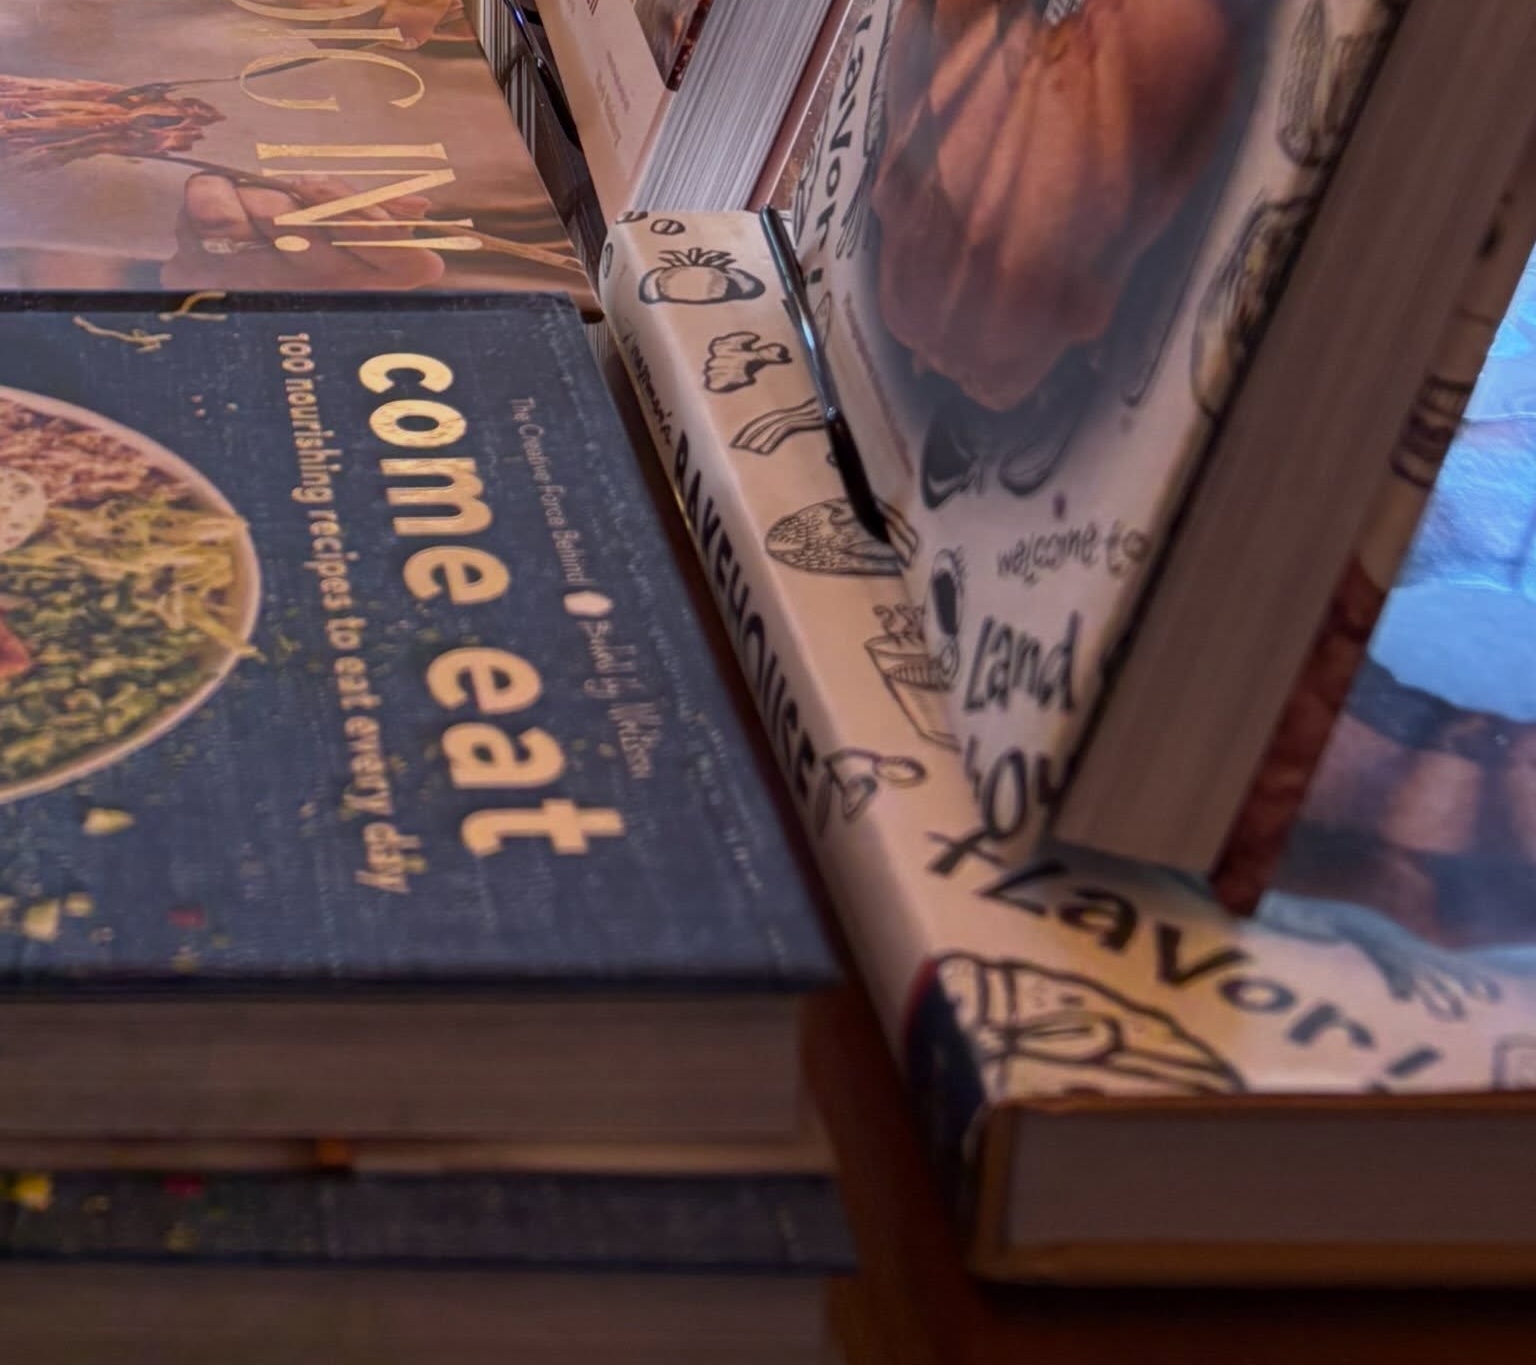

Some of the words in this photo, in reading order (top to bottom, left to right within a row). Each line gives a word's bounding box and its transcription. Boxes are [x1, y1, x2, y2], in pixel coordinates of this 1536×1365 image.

[256, 141, 484, 253] IN!
[277, 332, 315, 373] 100
[284, 377, 343, 504] nourishing
[511, 397, 536, 423] The
[359, 352, 510, 606] come
[517, 423, 552, 484] Creative
[539, 484, 568, 528] Force
[303, 509, 360, 611] recipes
[551, 529, 595, 587] Behind
[997, 520, 1100, 586] welcome
[325, 617, 368, 650] to
[964, 609, 1083, 713] Land
[333, 655, 383, 710] eat
[341, 715, 395, 816] every
[425, 645, 625, 857] eat
[354, 821, 423, 894] day
